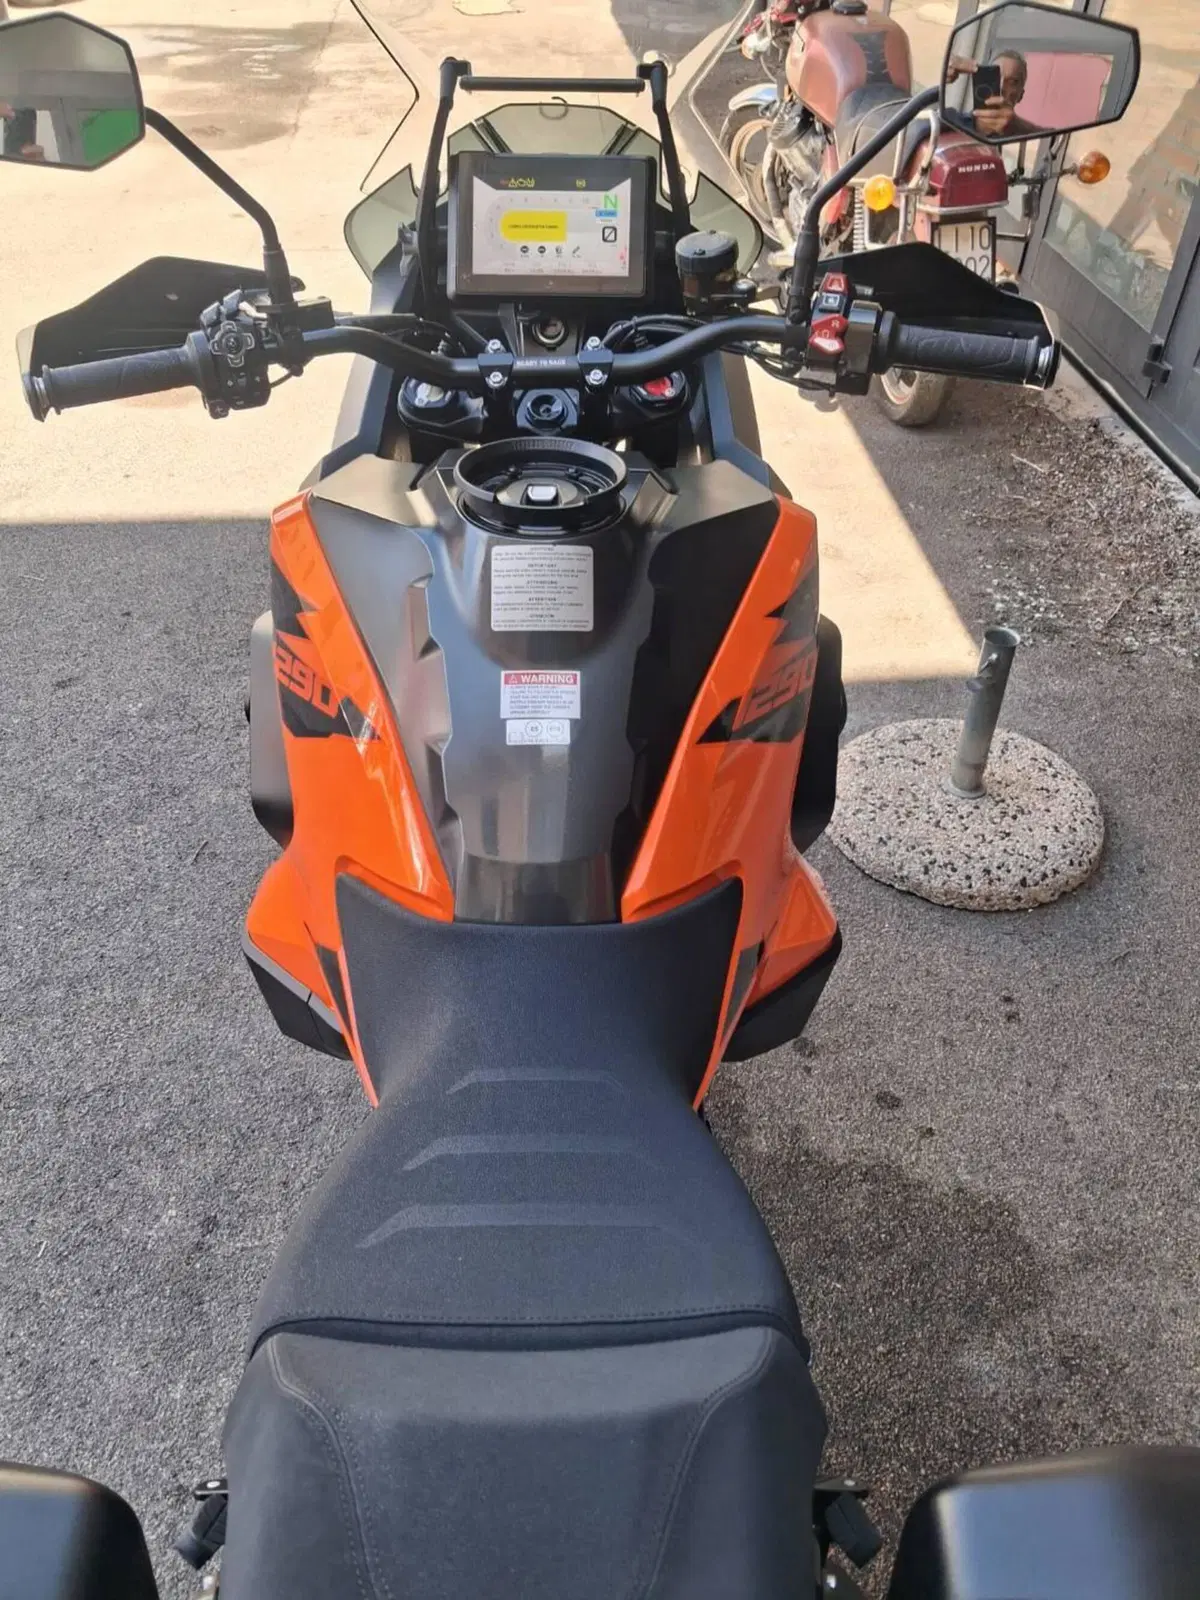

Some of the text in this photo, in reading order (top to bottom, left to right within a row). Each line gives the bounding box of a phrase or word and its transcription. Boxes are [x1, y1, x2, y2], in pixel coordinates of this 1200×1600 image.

[957, 162, 996, 174] HONDA
[603, 194, 618, 209] N
[520, 674, 574, 684] WARNING
